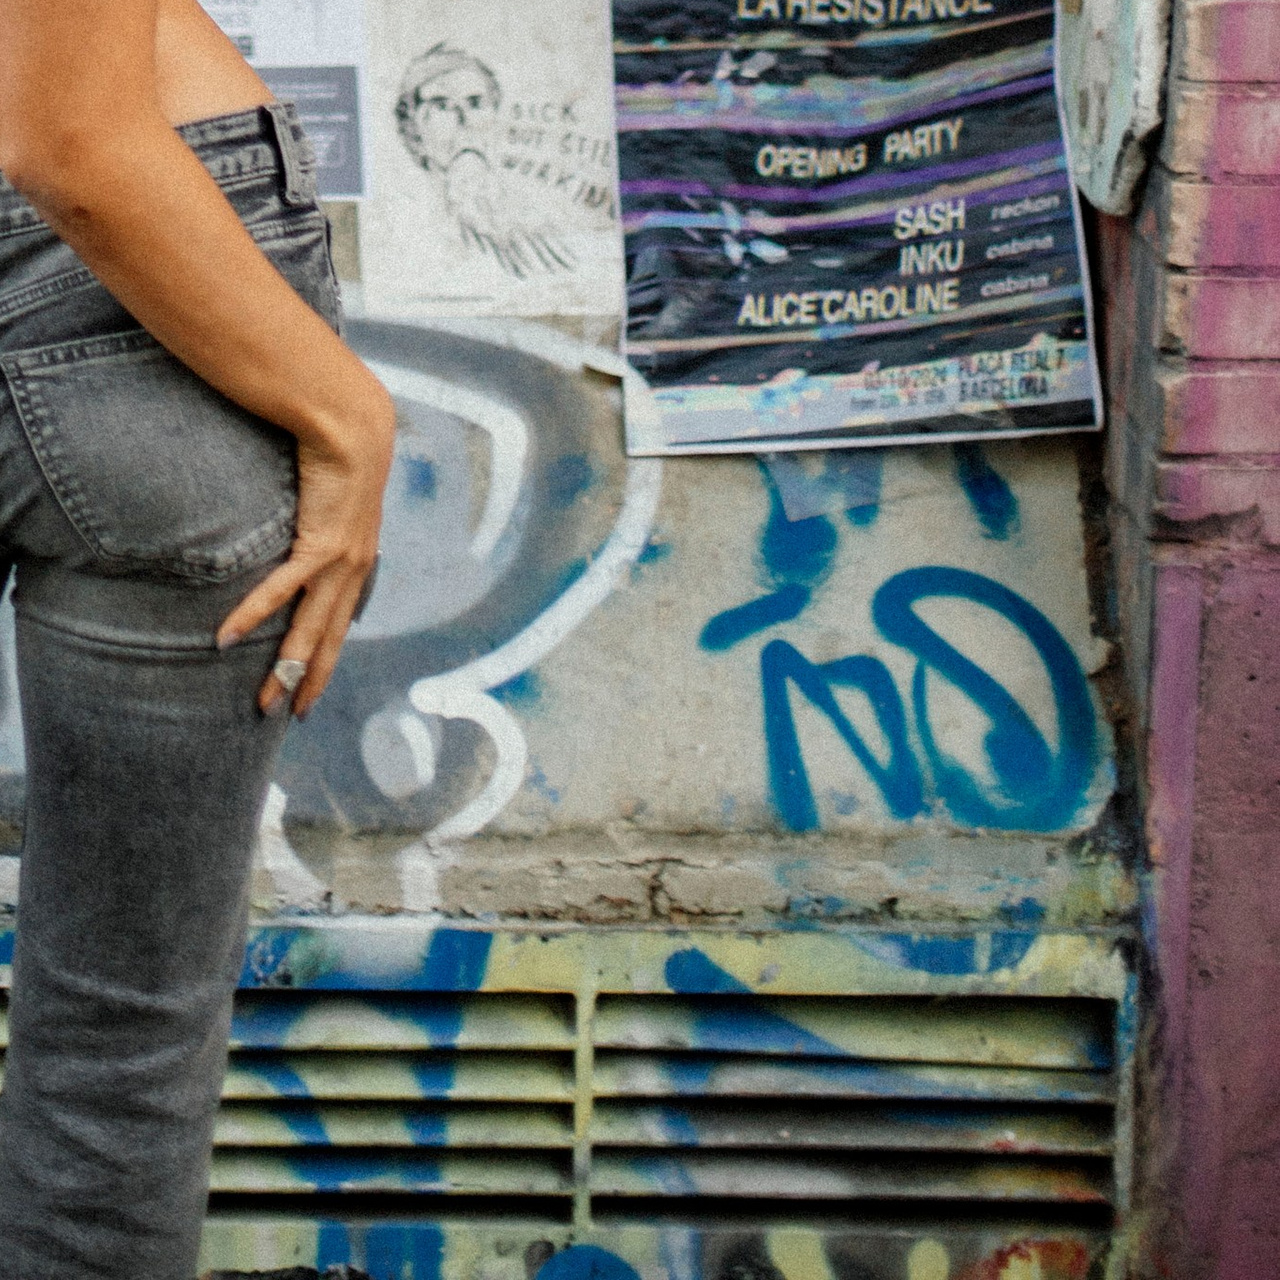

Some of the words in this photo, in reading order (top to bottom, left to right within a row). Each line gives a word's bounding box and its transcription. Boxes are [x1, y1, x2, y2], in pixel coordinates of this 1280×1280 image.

[510, 99, 580, 124] SICK
[754, 143, 868, 181] OPENING
[883, 117, 965, 163] PARTY
[500, 154, 616, 221] WORKIN
[894, 198, 967, 240] SASH
[899, 240, 966, 277] INKU
[738, 290, 820, 328] ALICE
[820, 279, 960, 324] CAROLINE
